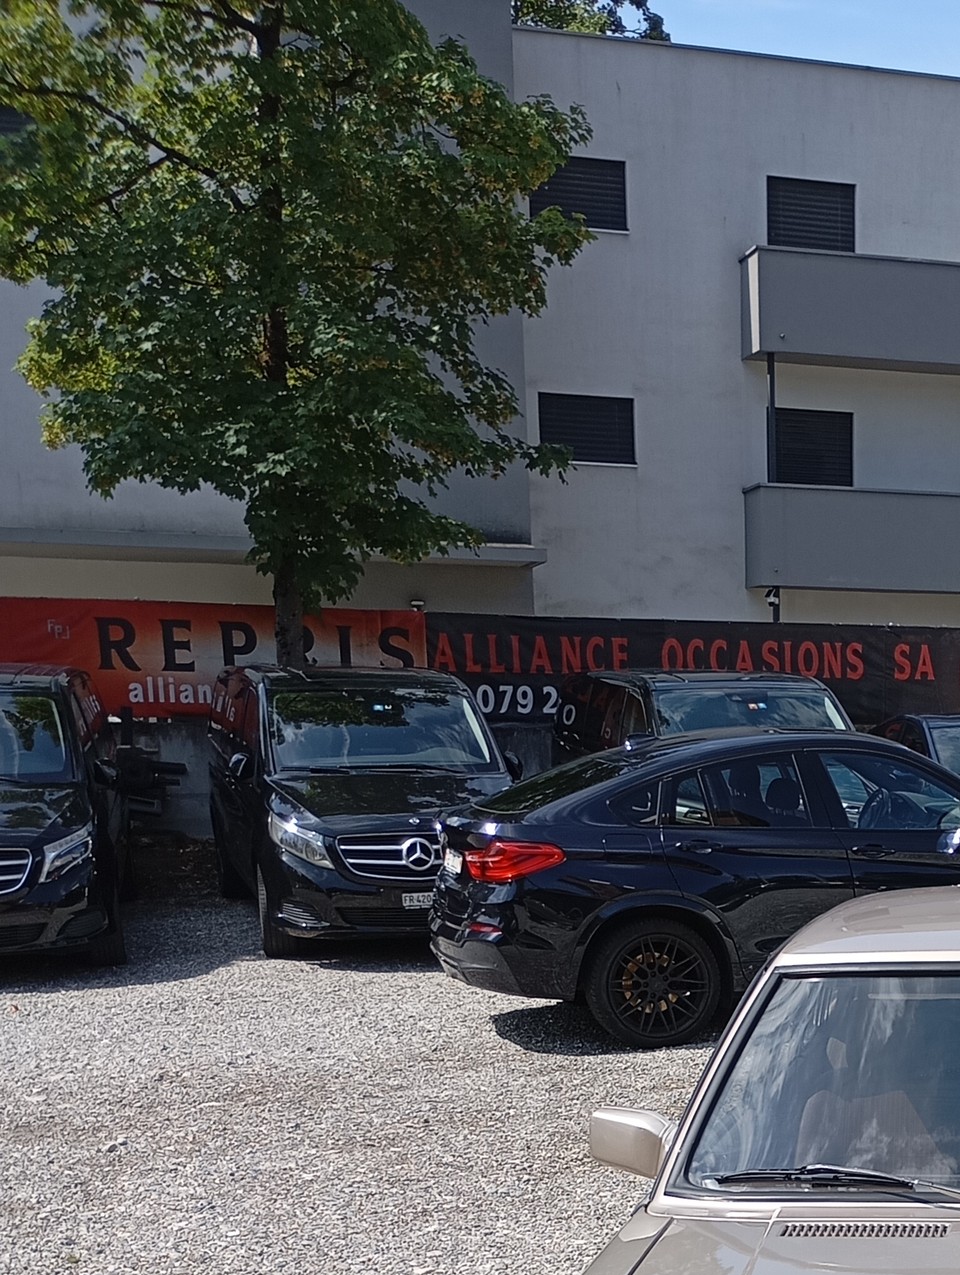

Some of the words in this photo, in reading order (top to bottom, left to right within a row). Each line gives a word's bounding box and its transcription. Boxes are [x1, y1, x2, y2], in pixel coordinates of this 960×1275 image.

[434, 632, 629, 674] ALLIANCE
[661, 637, 864, 680] OCCASIONS
[894, 643, 936, 680] SA
